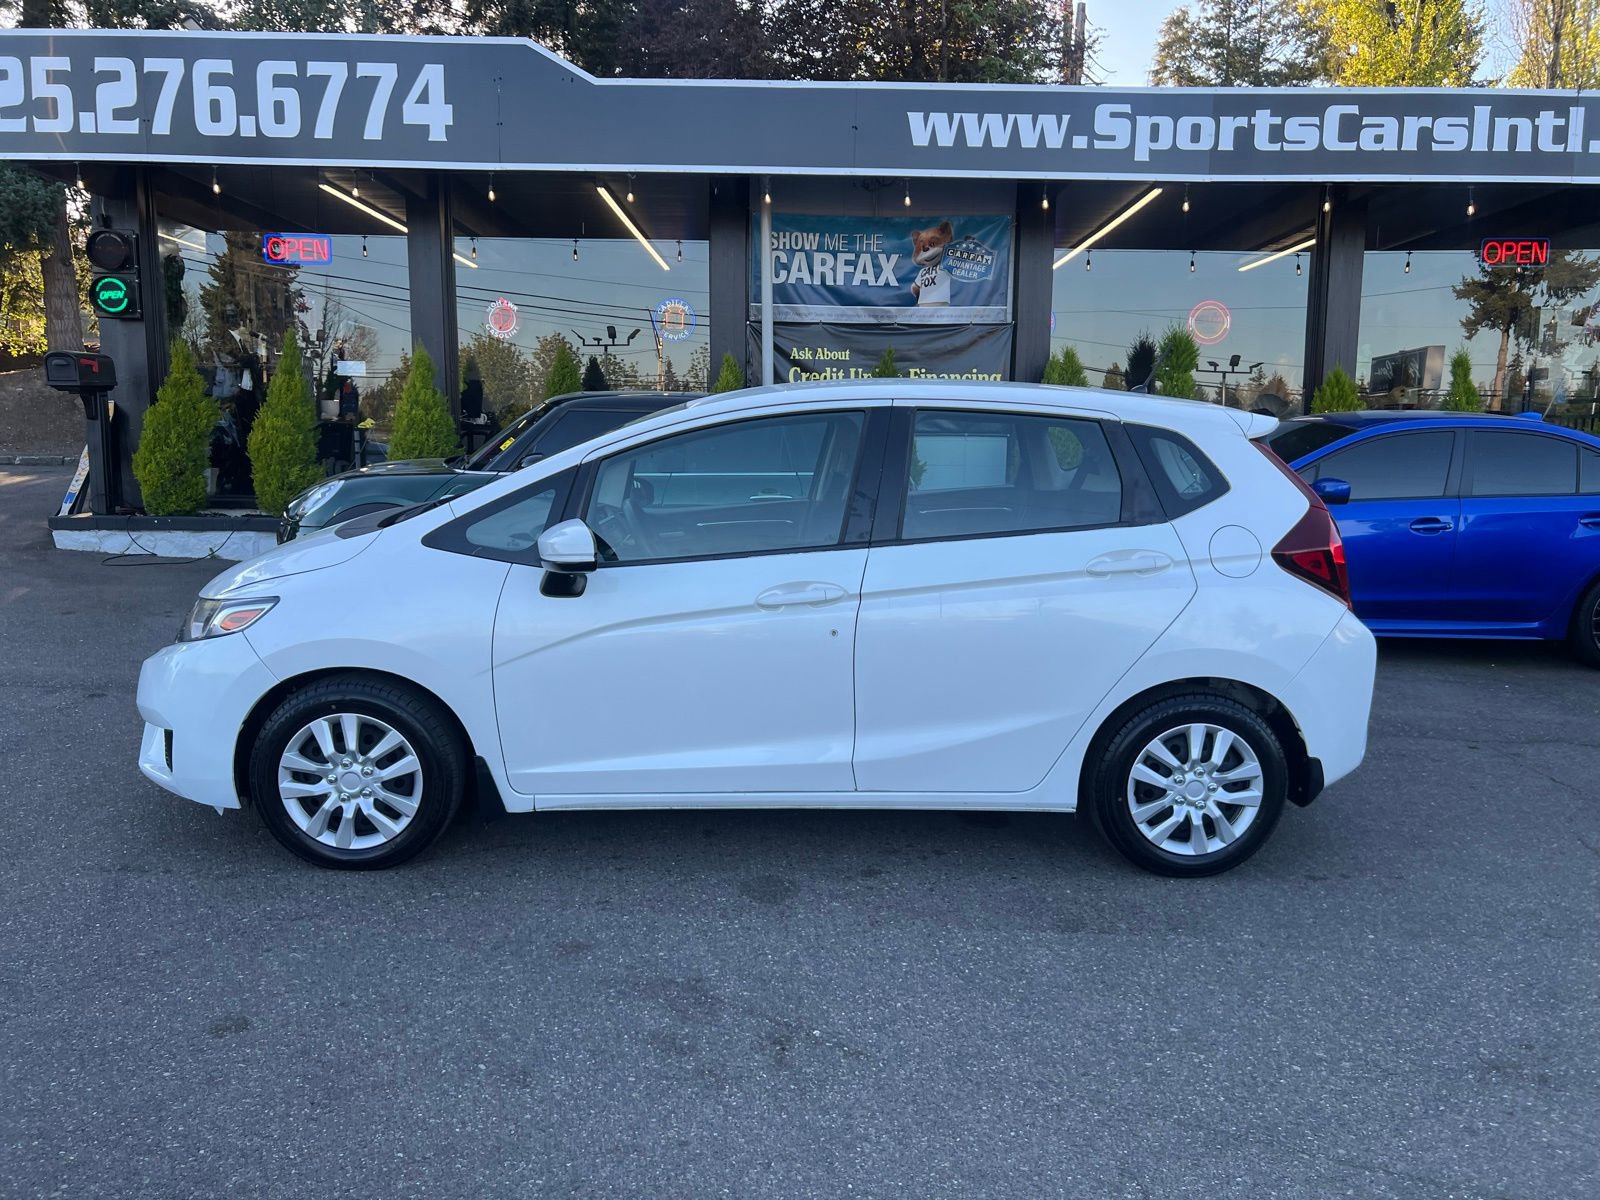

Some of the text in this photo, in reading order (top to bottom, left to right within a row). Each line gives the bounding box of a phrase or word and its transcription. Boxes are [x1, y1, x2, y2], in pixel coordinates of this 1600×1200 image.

[267, 237, 329, 261] OPEN
[770, 231, 883, 252] SHOW ME THE
[947, 249, 992, 265] CARFAX
[1484, 241, 1547, 264] OPEN
[771, 250, 900, 287] CARFAX
[948, 259, 986, 273] ADVANTAGE
[952, 269, 978, 279] DEALER
[920, 276, 937, 288] FOX
[99, 288, 125, 301] OPEN
[790, 347, 850, 361] Ask About
[788, 366, 845, 384] Credit
